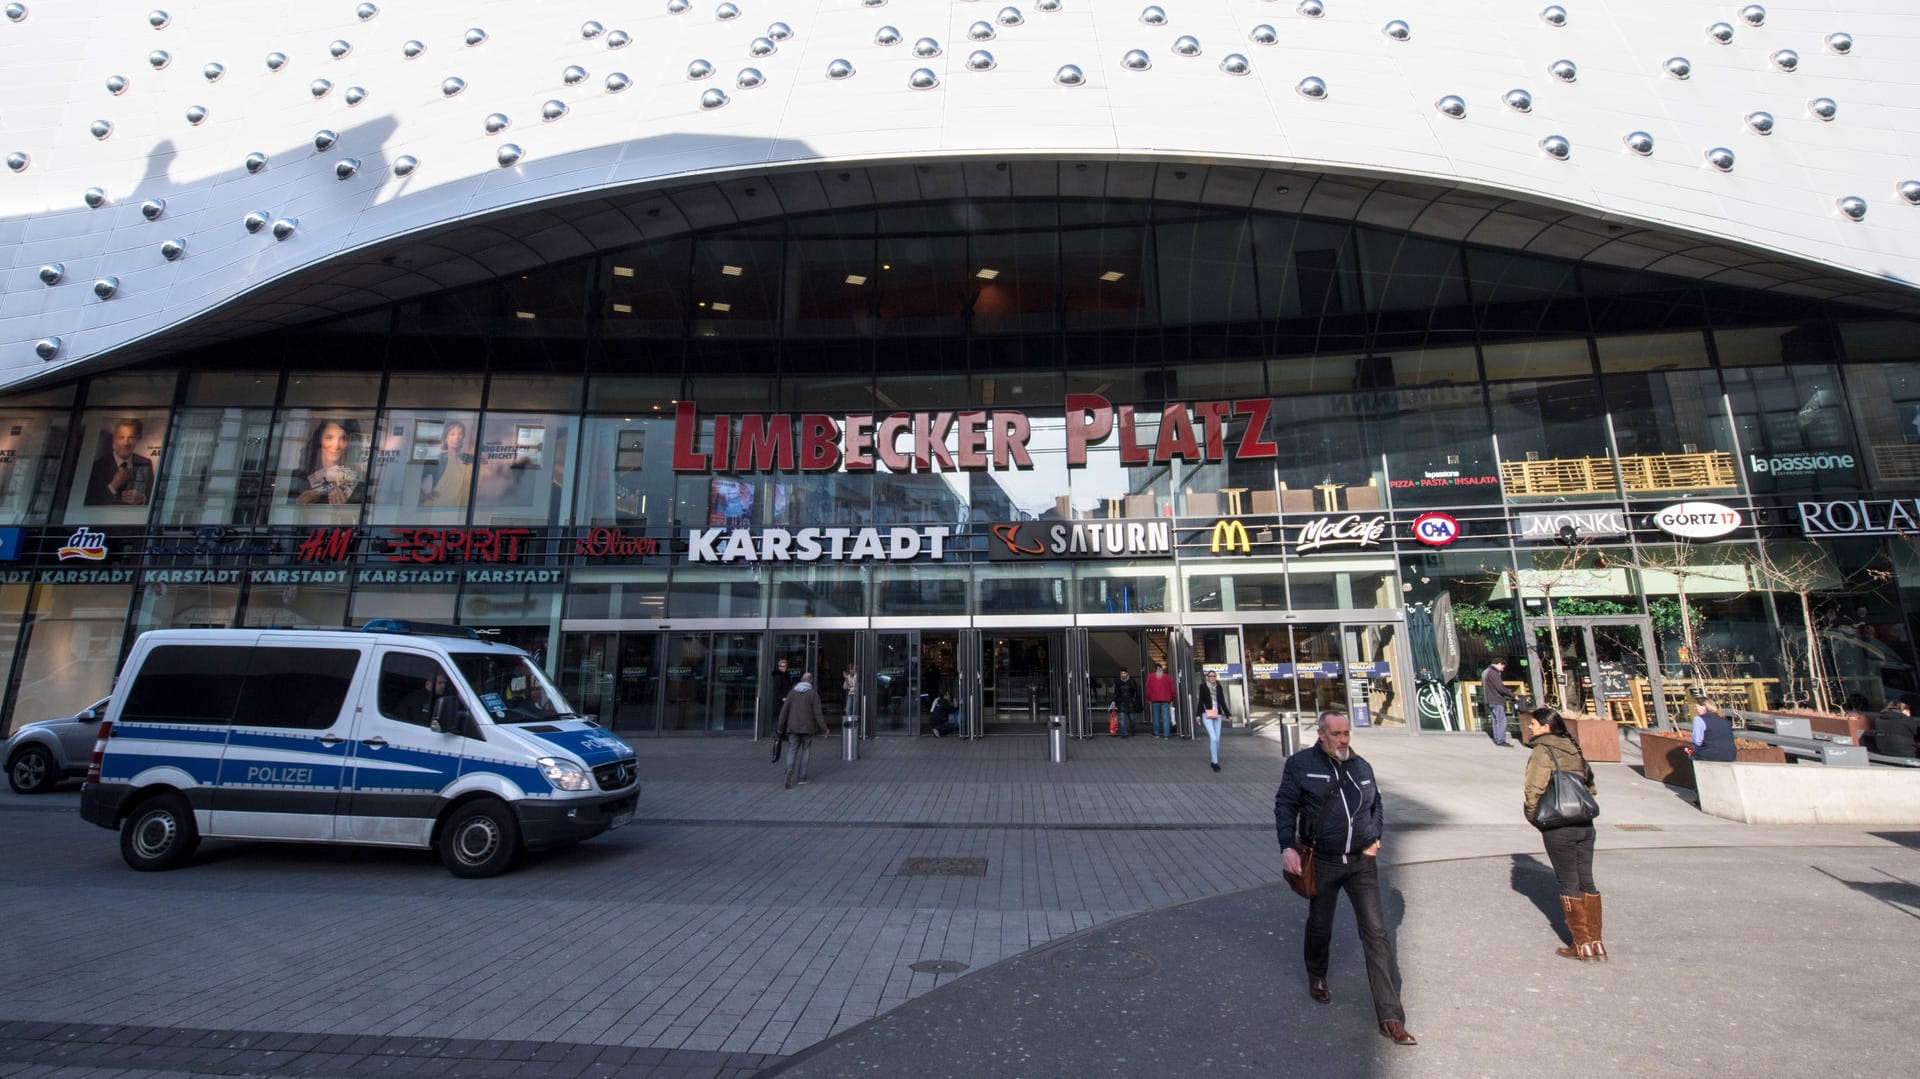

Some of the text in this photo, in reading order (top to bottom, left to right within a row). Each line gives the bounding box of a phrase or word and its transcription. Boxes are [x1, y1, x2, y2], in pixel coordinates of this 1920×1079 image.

[672, 393, 1279, 471] LIMBECKER PLATZ
[1390, 476, 1498, 488] PIZZA PASTA INSALATA
[1721, 513, 1735, 525] 17
[1797, 498, 1920, 533] ROLA
[1421, 522, 1452, 537] C&A
[68, 527, 106, 549] dm
[297, 527, 353, 561] H&M
[384, 528, 529, 562] ESPRIT
[688, 526, 949, 562] KARSTADT
[1050, 522, 1169, 554] SATURN
[40, 570, 134, 583] KARSTADT
[144, 570, 240, 583] KARSTADT
[250, 570, 347, 583] KARSTADT
[358, 570, 456, 583] KARSTADT
[465, 570, 561, 583] KARSTADT
[247, 766, 313, 783] POLIZEI
